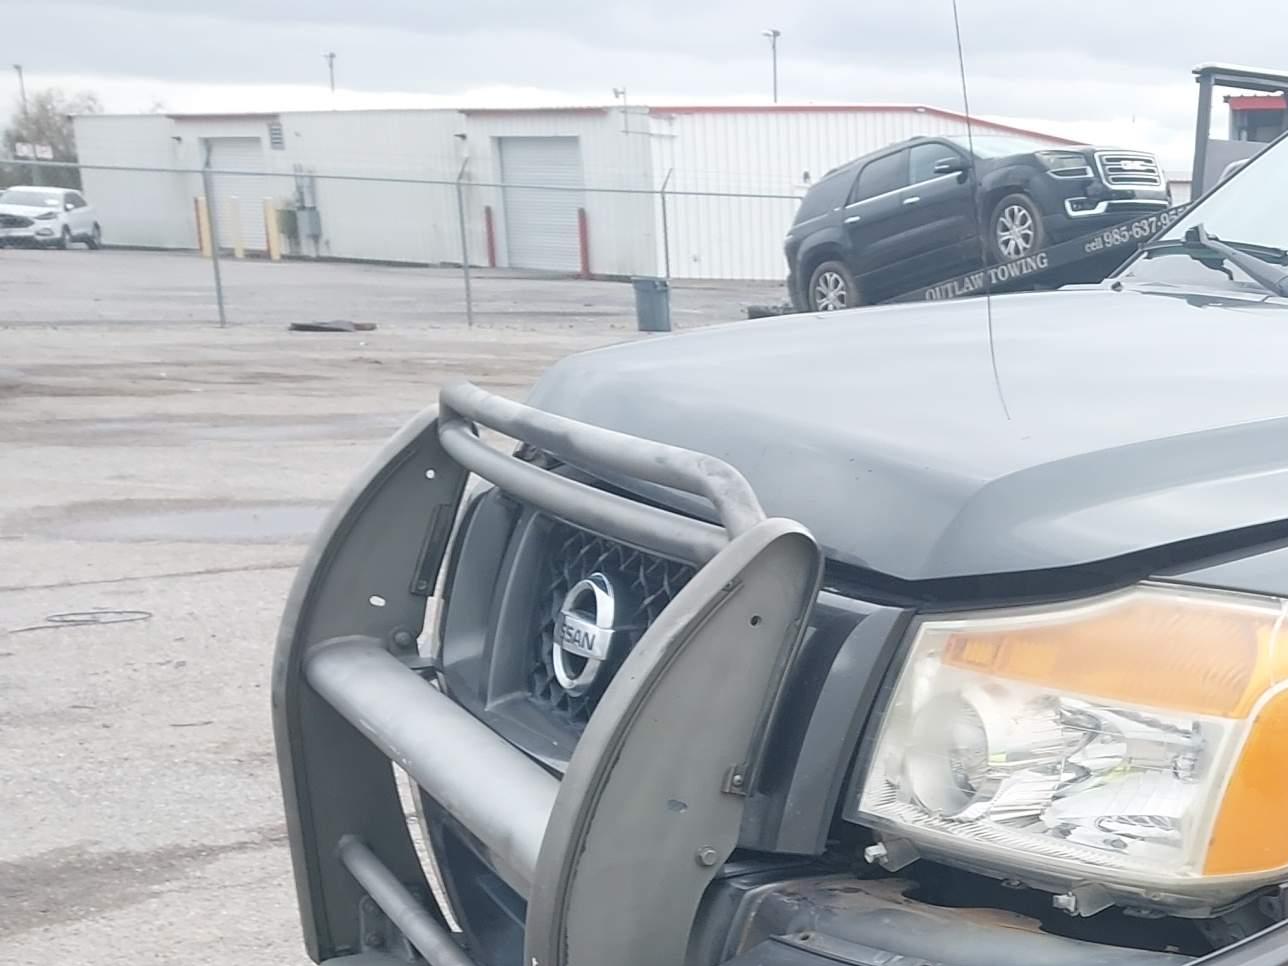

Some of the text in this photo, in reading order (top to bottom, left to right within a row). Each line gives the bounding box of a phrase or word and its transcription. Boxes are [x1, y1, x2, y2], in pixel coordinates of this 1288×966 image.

[925, 252, 1048, 301] OUTLAW TOWING
[560, 622, 596, 651] SSAN
